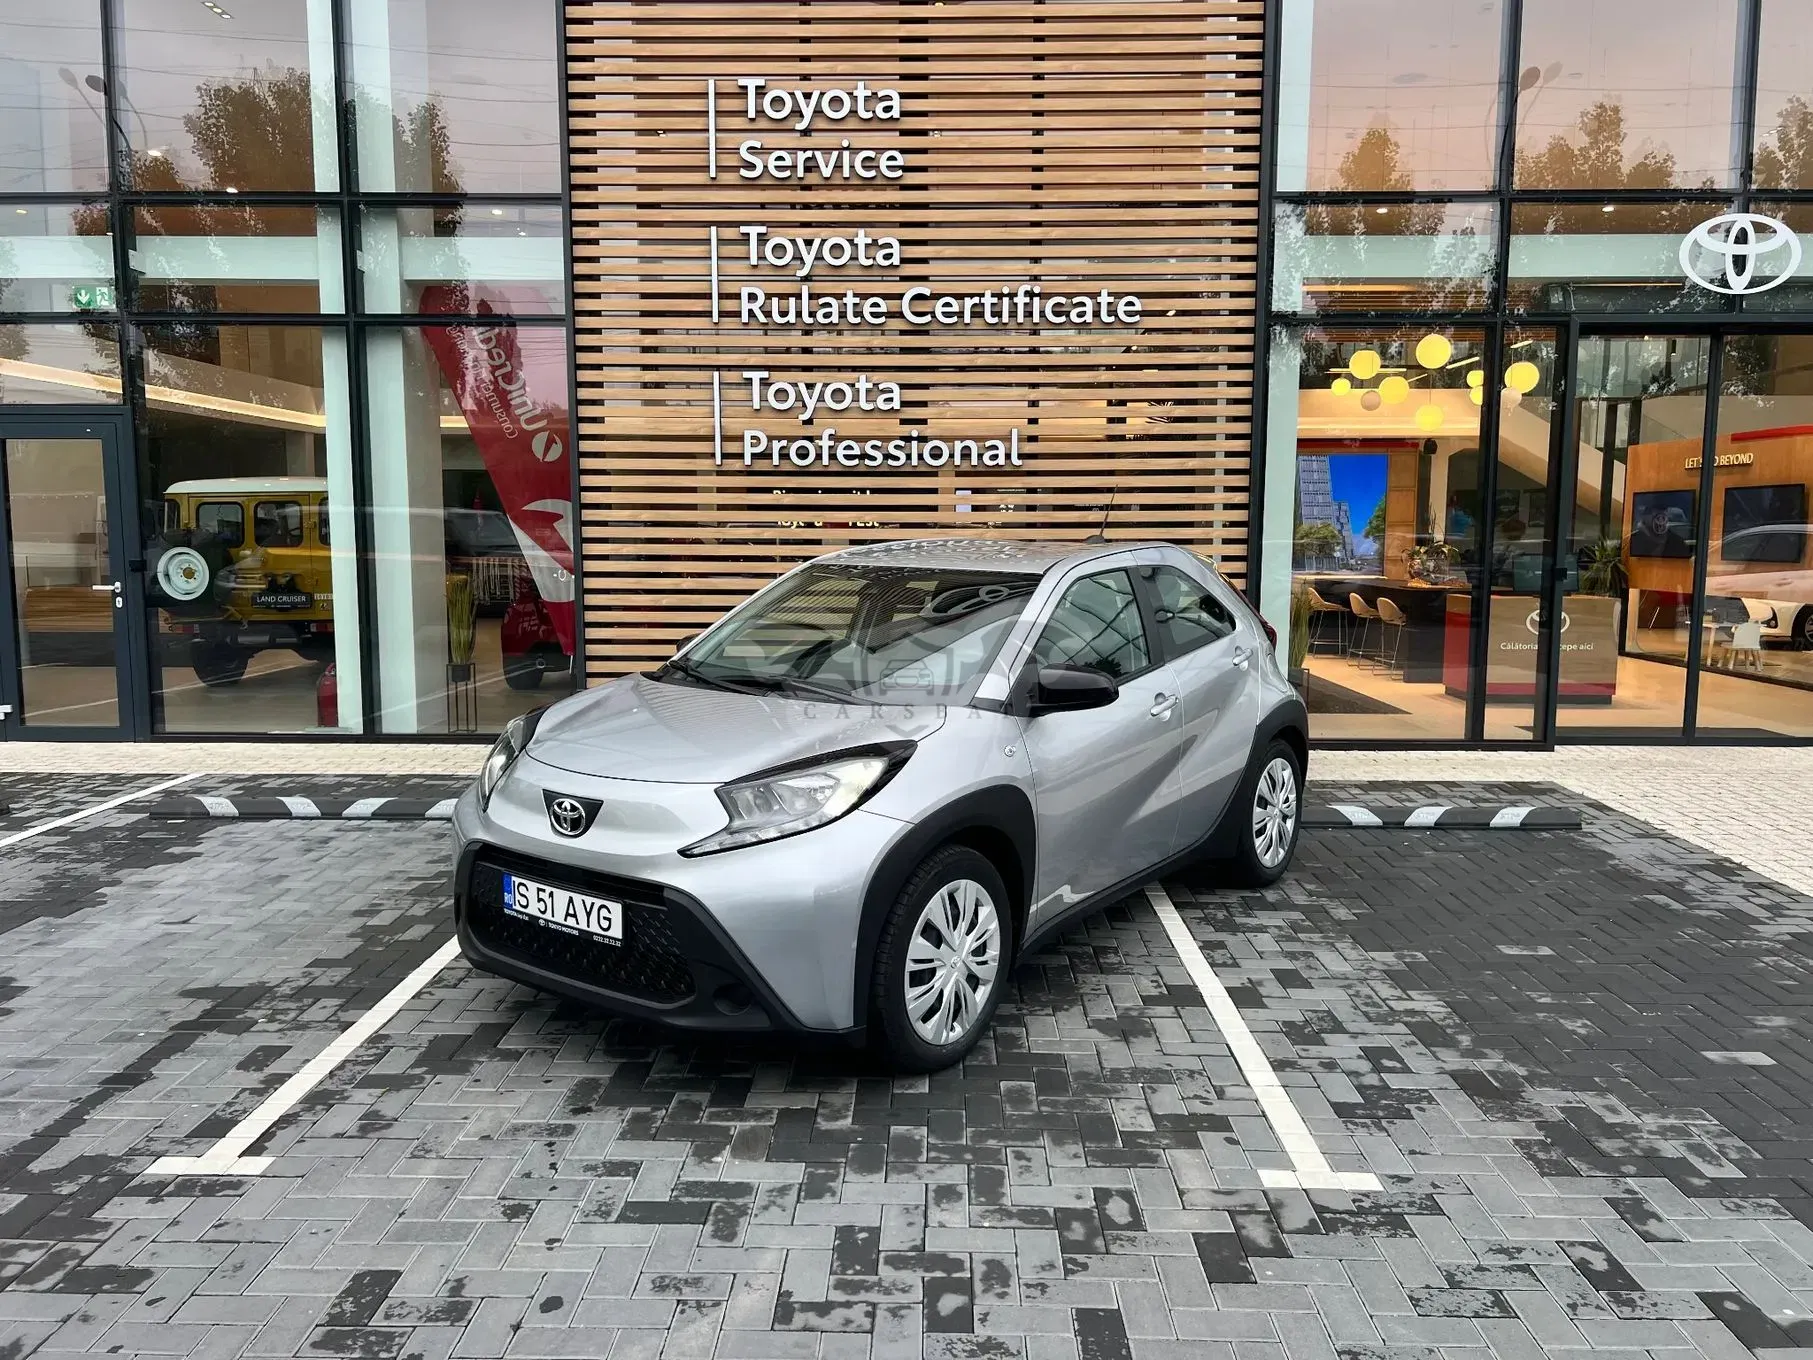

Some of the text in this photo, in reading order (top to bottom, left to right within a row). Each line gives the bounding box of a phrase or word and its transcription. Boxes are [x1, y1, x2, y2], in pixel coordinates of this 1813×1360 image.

[737, 79, 900, 130] Toyota
[739, 139, 904, 178] Service
[739, 226, 900, 276] Toyota
[741, 284, 1142, 325] Rulate Certificate
[742, 371, 900, 420] Toyota
[743, 428, 1022, 466] Professional
[1720, 453, 1753, 465] BEYOND
[1579, 642, 1594, 650] aici
[512, 880, 612, 932] IS 51 AYG
